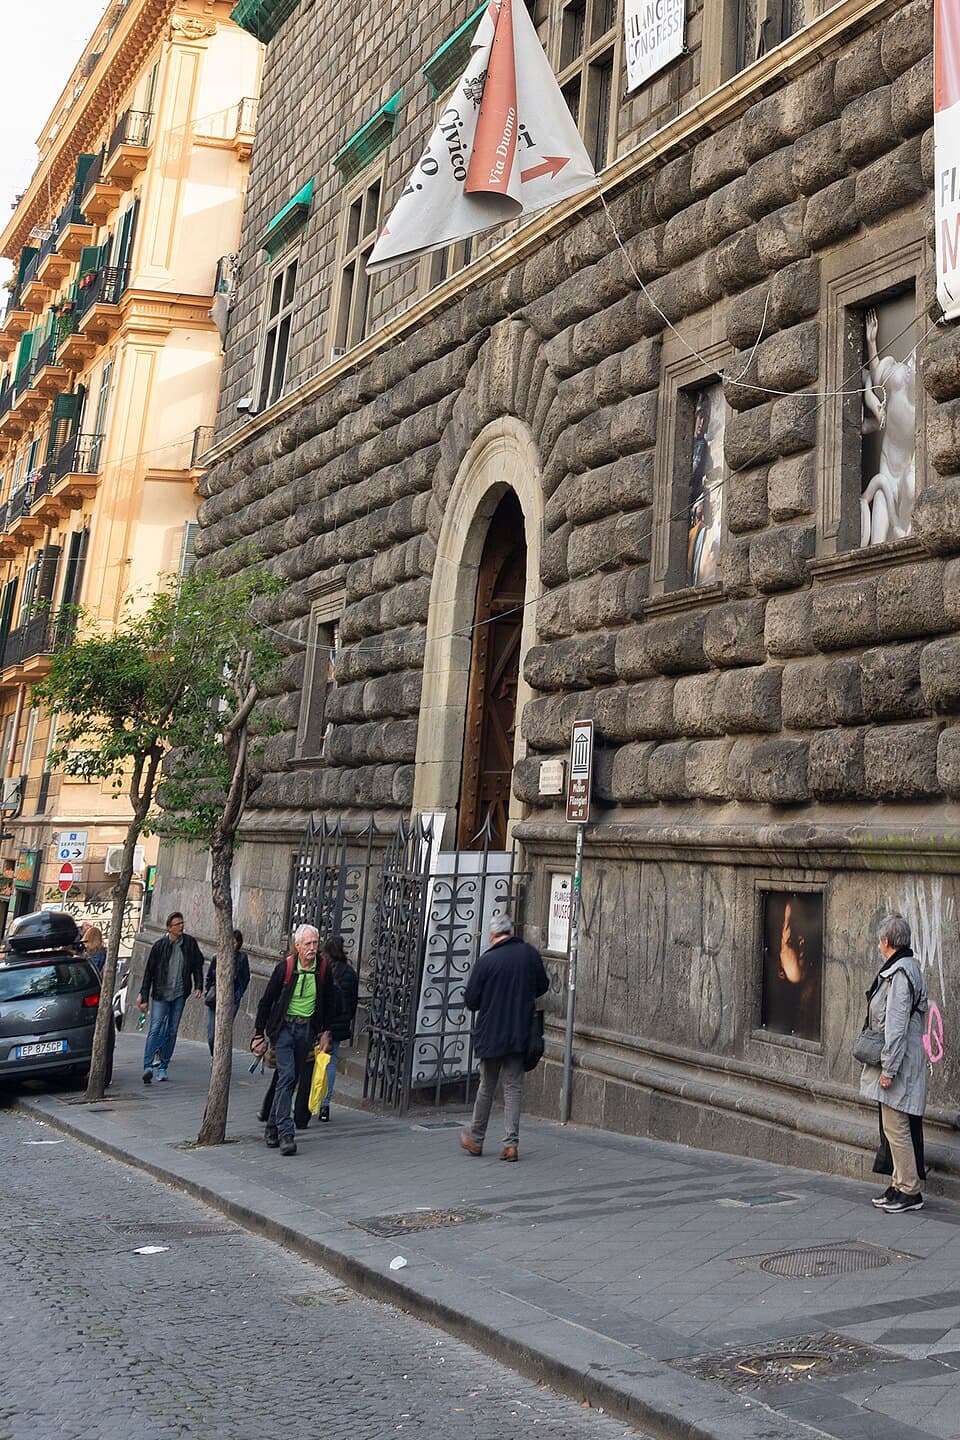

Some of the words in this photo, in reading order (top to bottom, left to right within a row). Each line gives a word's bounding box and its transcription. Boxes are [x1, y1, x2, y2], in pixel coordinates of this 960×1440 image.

[628, 8, 684, 66] CONGRESSI
[438, 109, 467, 182] Civico
[495, 107, 517, 159] Duomo
[489, 159, 506, 185] Via
